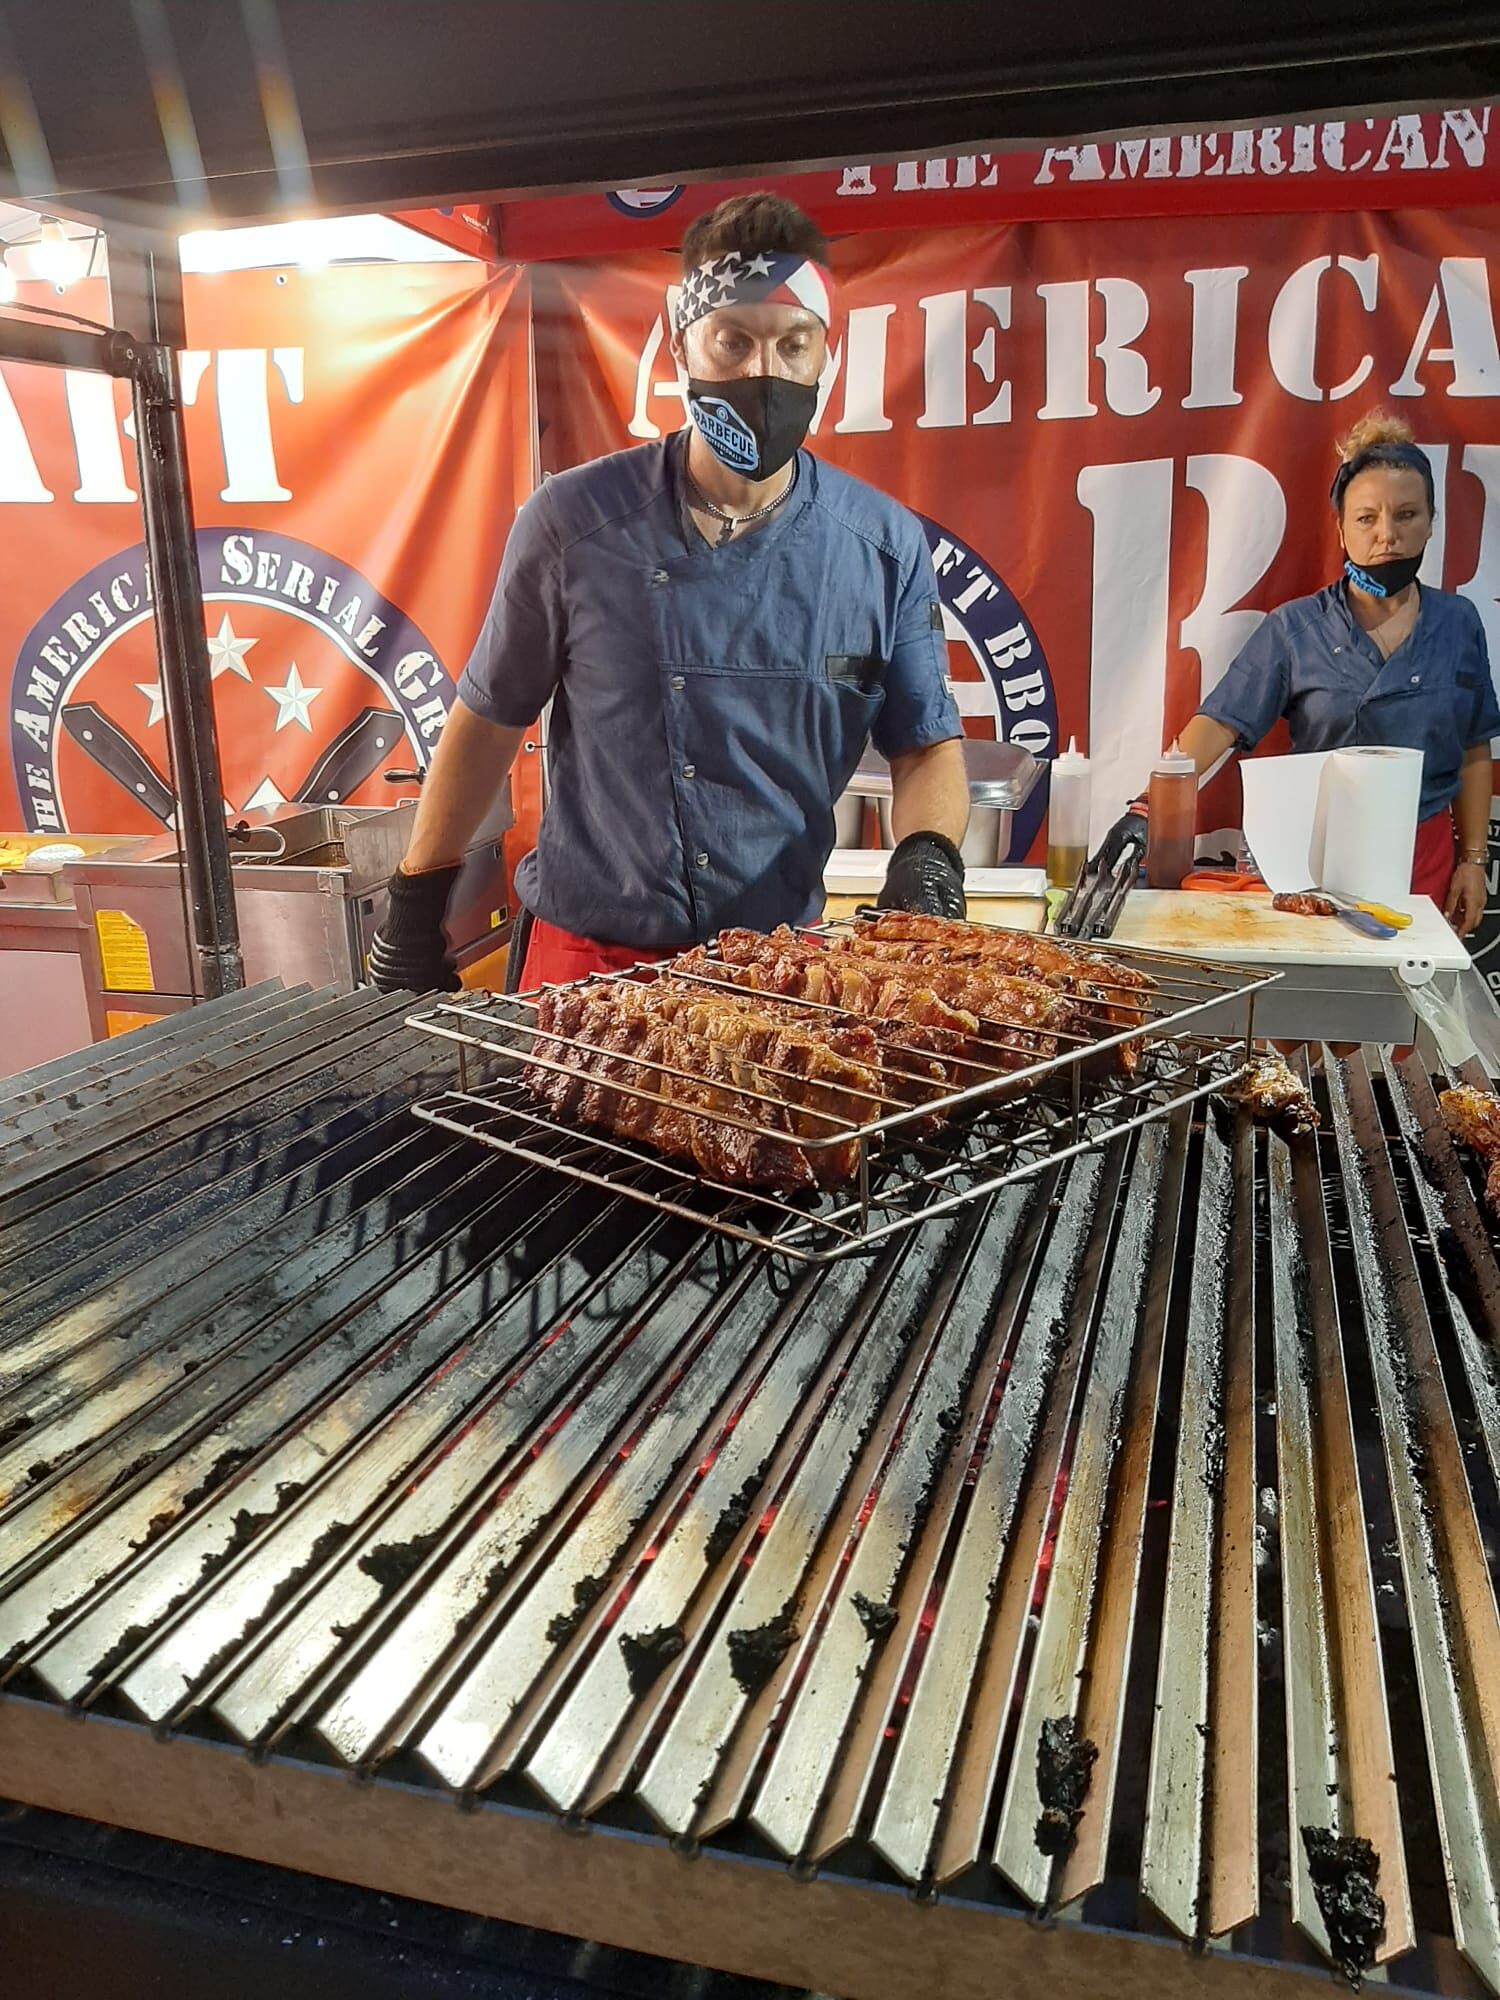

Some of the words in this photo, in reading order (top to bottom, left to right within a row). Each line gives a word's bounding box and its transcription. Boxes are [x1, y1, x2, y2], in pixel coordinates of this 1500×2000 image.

[1033, 107, 1491, 184] AMERICAN
[693, 406, 755, 459] BARBECUE
[220, 534, 387, 658] SERIAL
[14, 562, 155, 754] AMERIC
[393, 650, 449, 758] GR
[26, 762, 60, 834] HE
